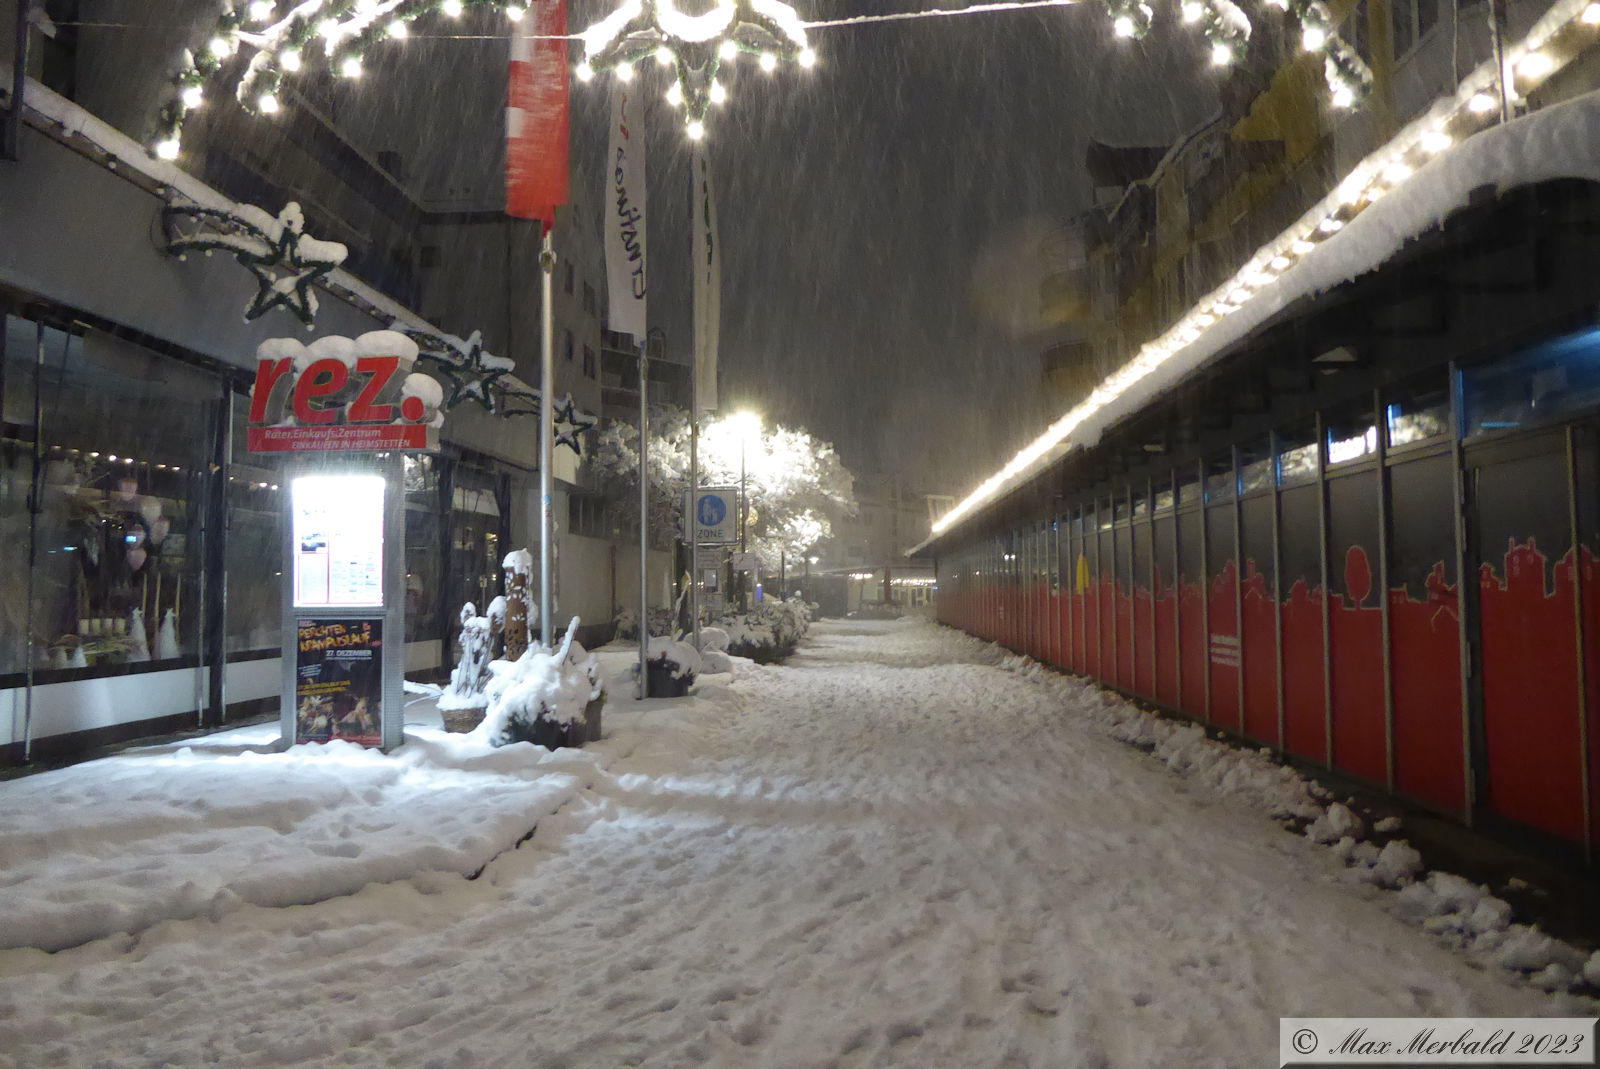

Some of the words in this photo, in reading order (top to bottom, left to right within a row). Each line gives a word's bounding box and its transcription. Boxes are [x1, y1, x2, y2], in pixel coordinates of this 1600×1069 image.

[249, 356, 424, 423] rez.
[341, 440, 351, 448] IN
[352, 439, 411, 449] HEIMSTETTEN
[697, 529, 724, 539] ZONE
